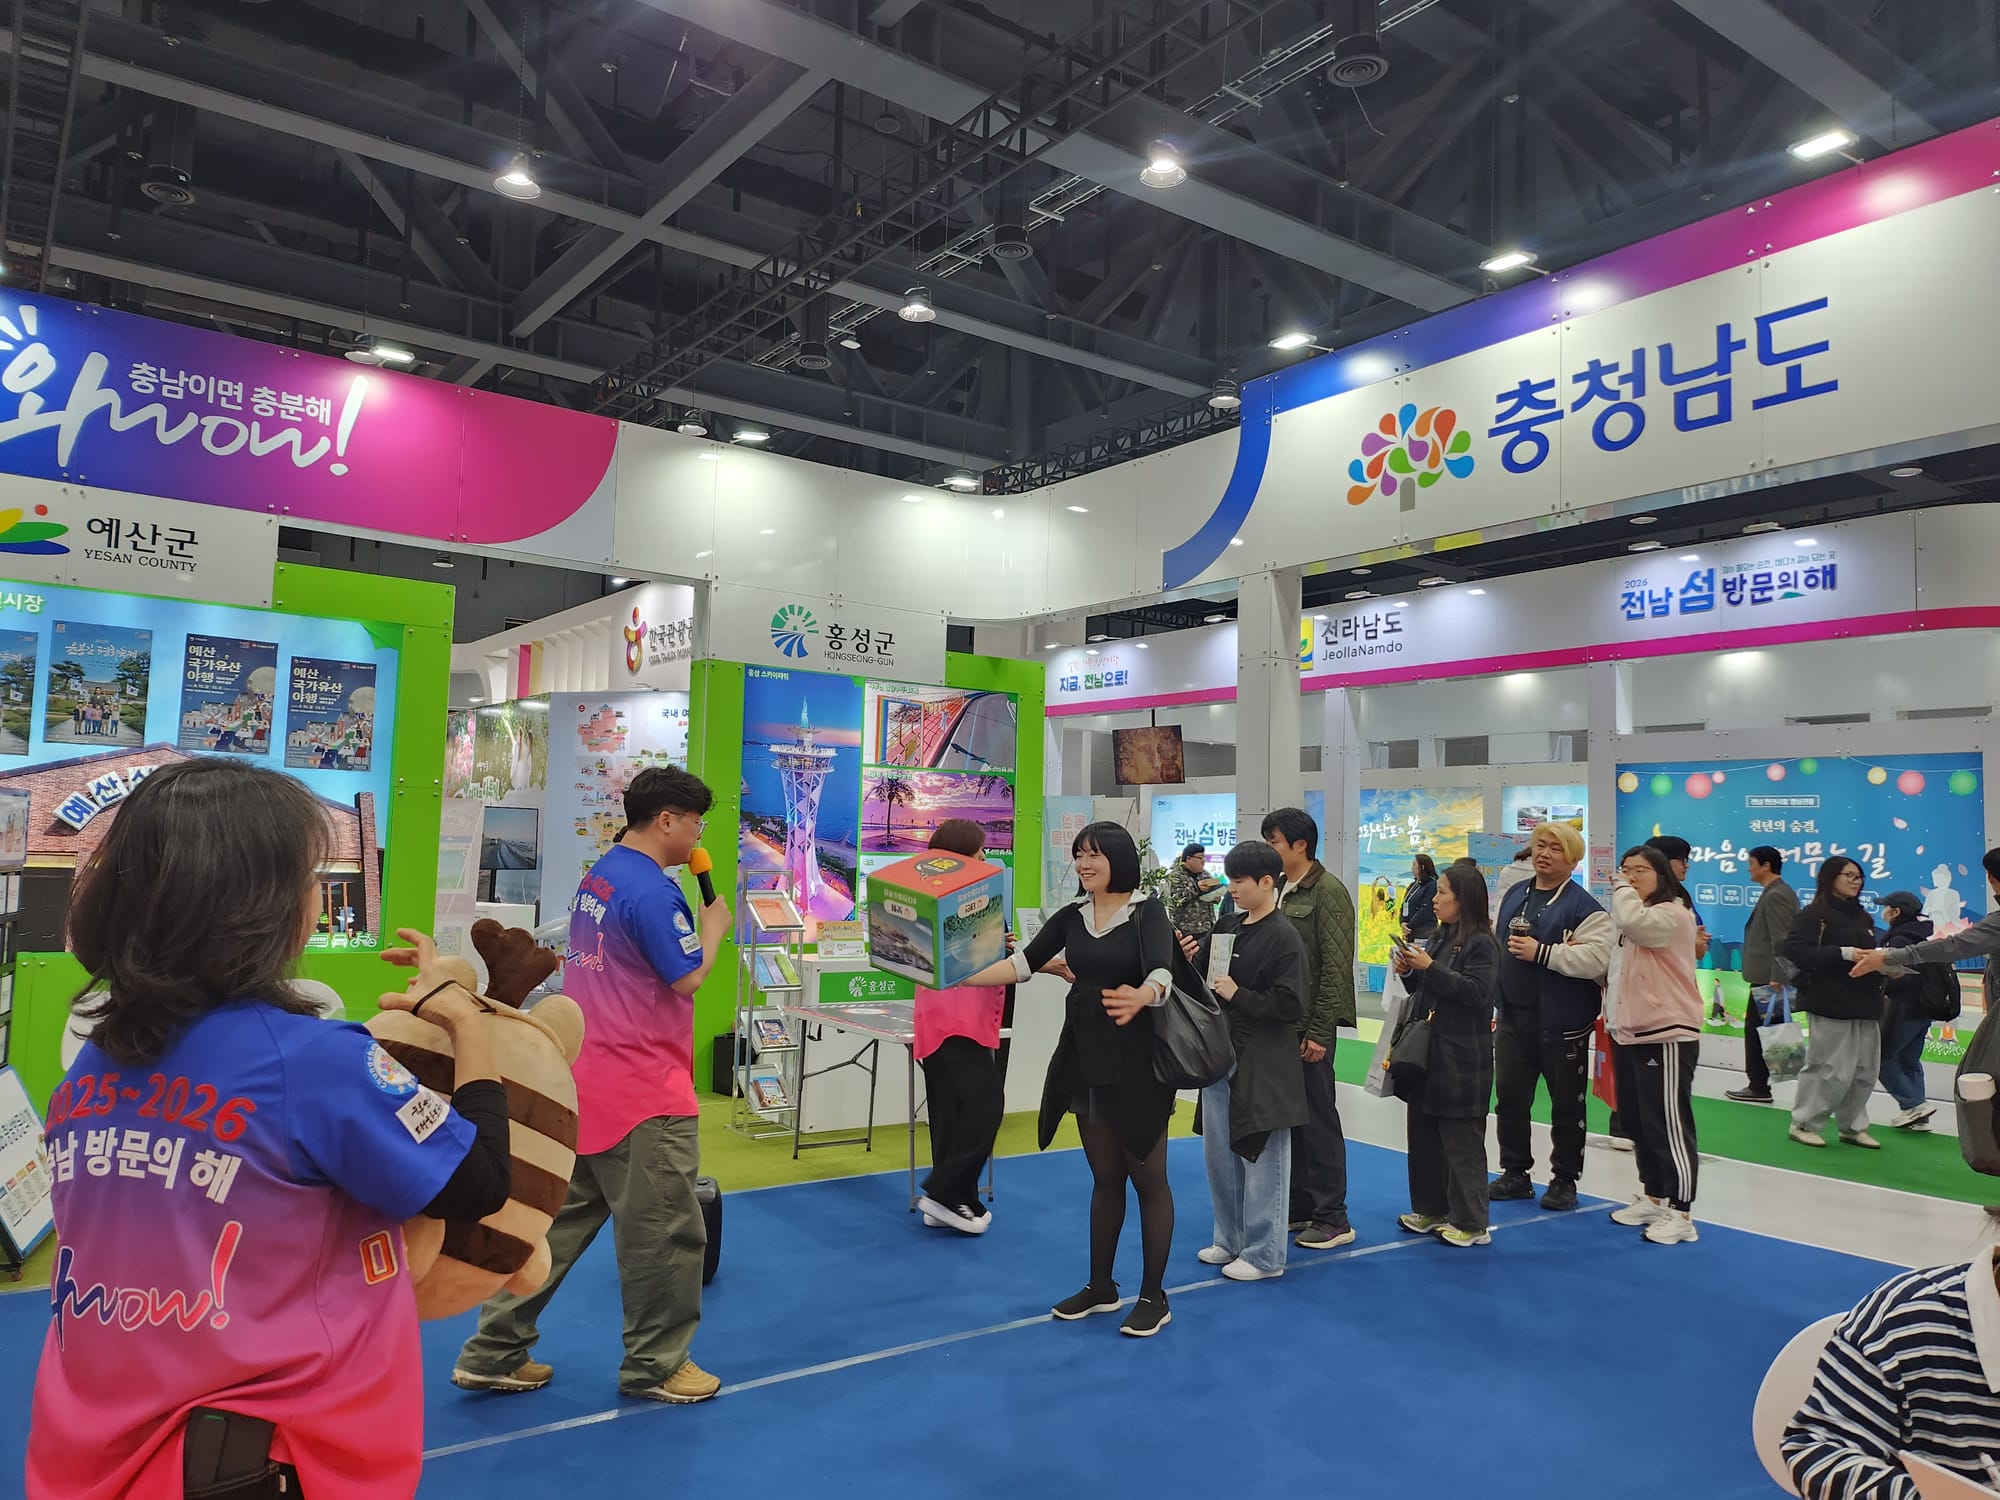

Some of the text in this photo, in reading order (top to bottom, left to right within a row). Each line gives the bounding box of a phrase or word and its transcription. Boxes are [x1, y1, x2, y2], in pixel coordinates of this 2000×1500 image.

[128, 362, 332, 426] 충남이면 충분해
[1487, 296, 1838, 473] 충청남도
[86, 516, 199, 559] 예산군
[84, 548, 197, 573] YESAN COUNTY
[1620, 586, 1674, 621] 전남
[1679, 567, 1716, 615] 섬
[1624, 578, 1648, 589] 2026
[1321, 611, 1403, 645] 전라남도
[825, 624, 895, 656] 홍성군
[189, 645, 216, 658] 예산
[824, 651, 894, 666] HONGSEONG-GUN
[1322, 641, 1403, 662] JeollaNamdo
[188, 657, 242, 673] 국가유산
[293, 667, 319, 680] 예산
[187, 669, 214, 683] 야행
[292, 679, 343, 694] 국가유산
[1060, 670, 1128, 692] 지금, 전남으로!
[292, 690, 317, 704] 야행
[661, 708, 678, 718] 국내
[1175, 829, 1197, 846] 전남
[1199, 822, 1214, 846] 섬
[1407, 815, 1421, 845] 봄
[1750, 819, 1819, 834] 천년의 숨결,
[868, 980, 896, 992] 홍성군
[84, 1127, 186, 1190] 방문의
[190, 1149, 242, 1204] 해
